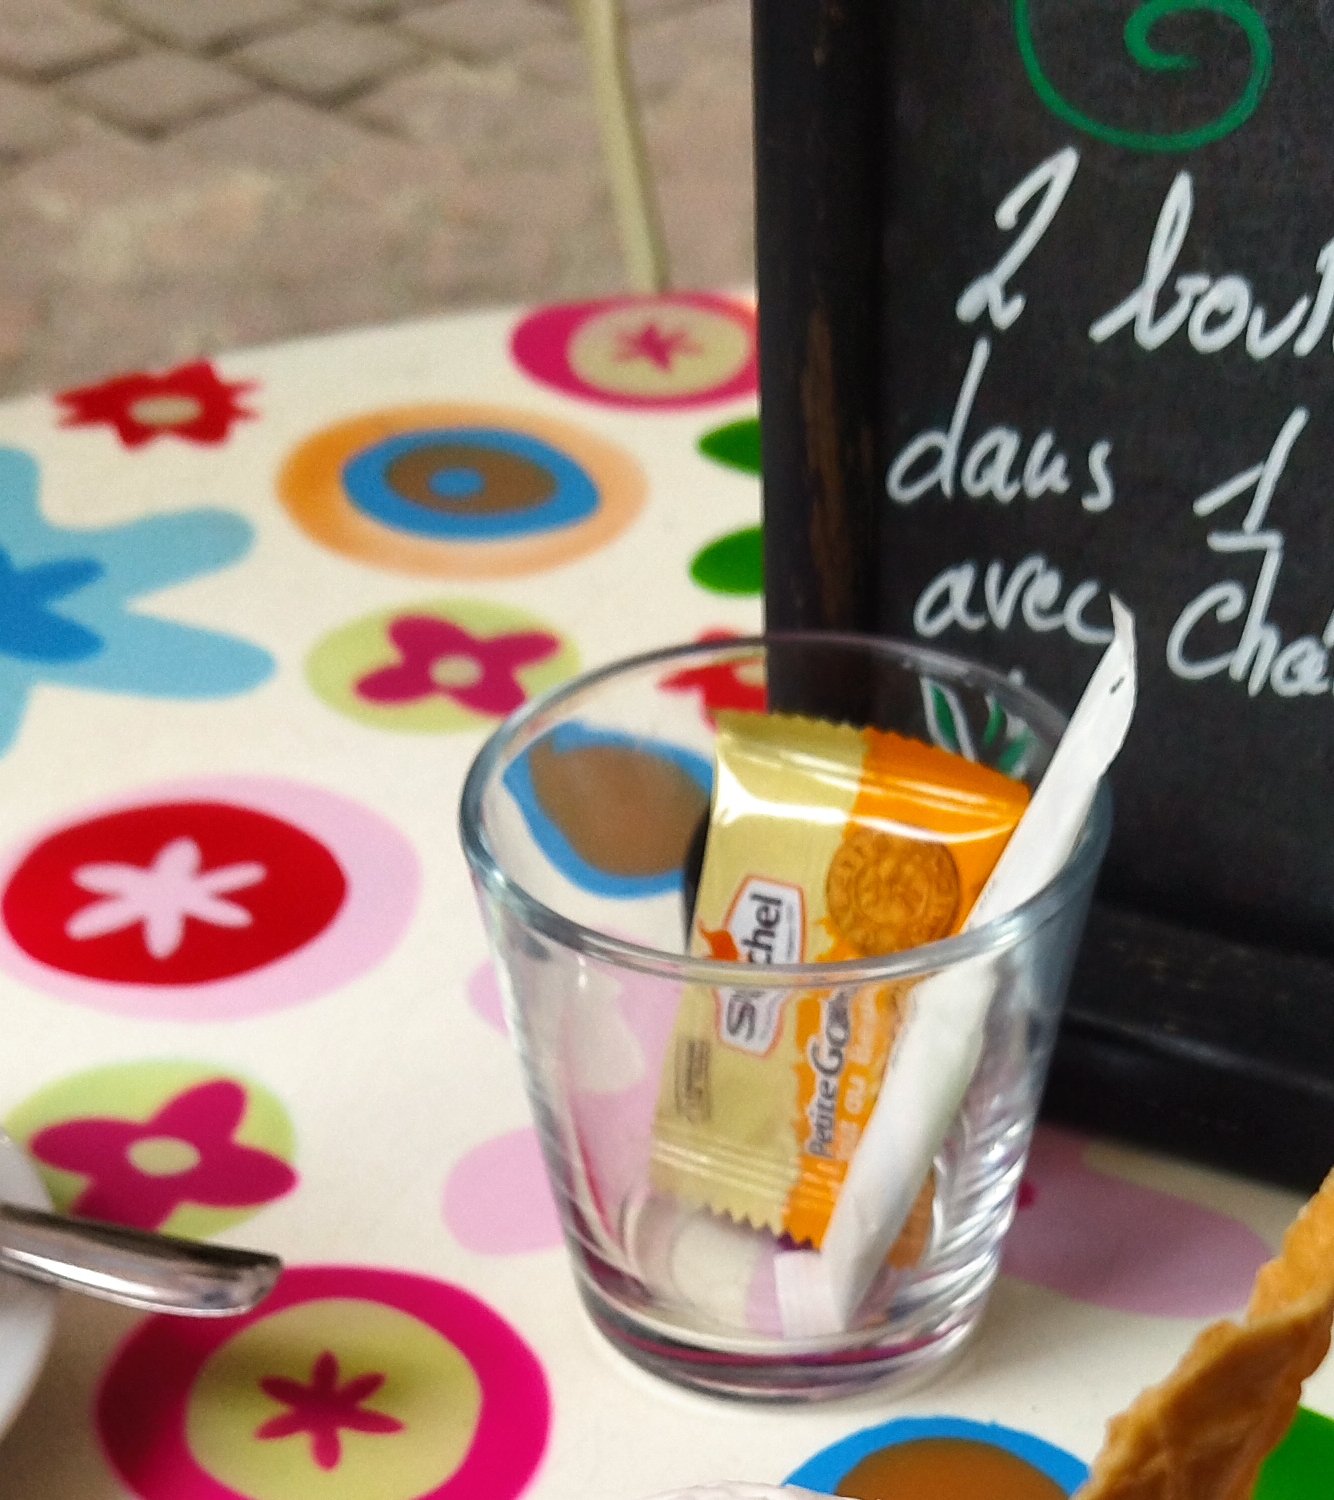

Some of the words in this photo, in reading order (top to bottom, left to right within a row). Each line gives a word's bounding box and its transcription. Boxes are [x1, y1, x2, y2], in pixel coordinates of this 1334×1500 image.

[955, 145, 1080, 331] 2
[886, 337, 1114, 513] dans
[1191, 406, 1310, 553] 1
[913, 553, 1119, 646] avec
